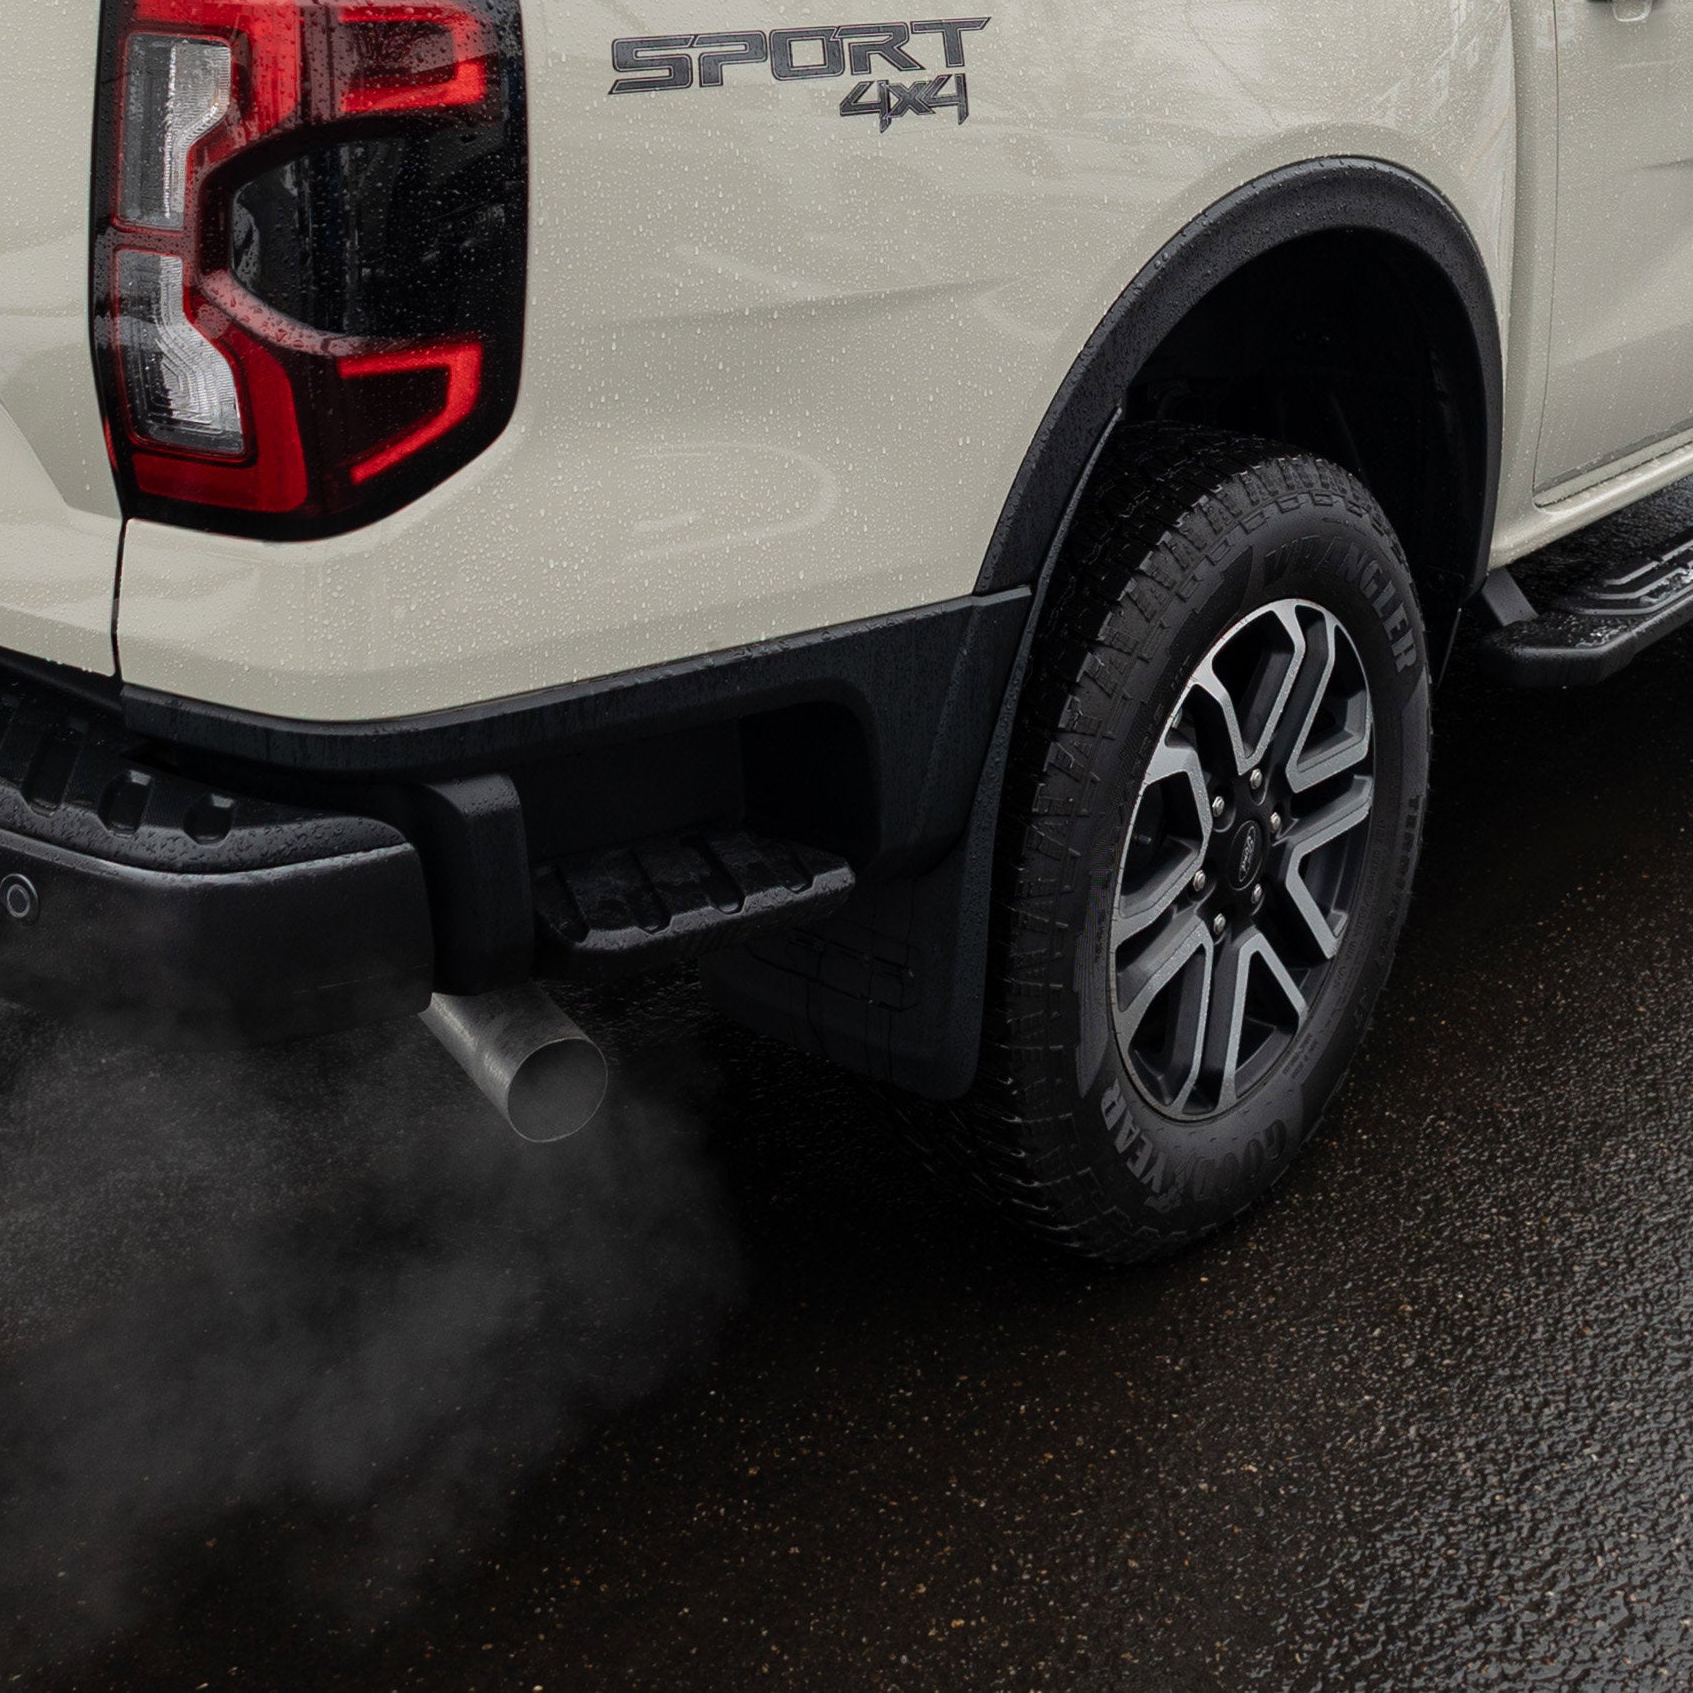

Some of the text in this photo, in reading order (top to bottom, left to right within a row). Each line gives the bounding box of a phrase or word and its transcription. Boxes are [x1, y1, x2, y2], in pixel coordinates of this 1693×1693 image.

[608, 16, 991, 95] SPORT
[1263, 534, 1418, 674] WRANGLER
[1100, 1078, 1288, 1203] GOODYEAR
